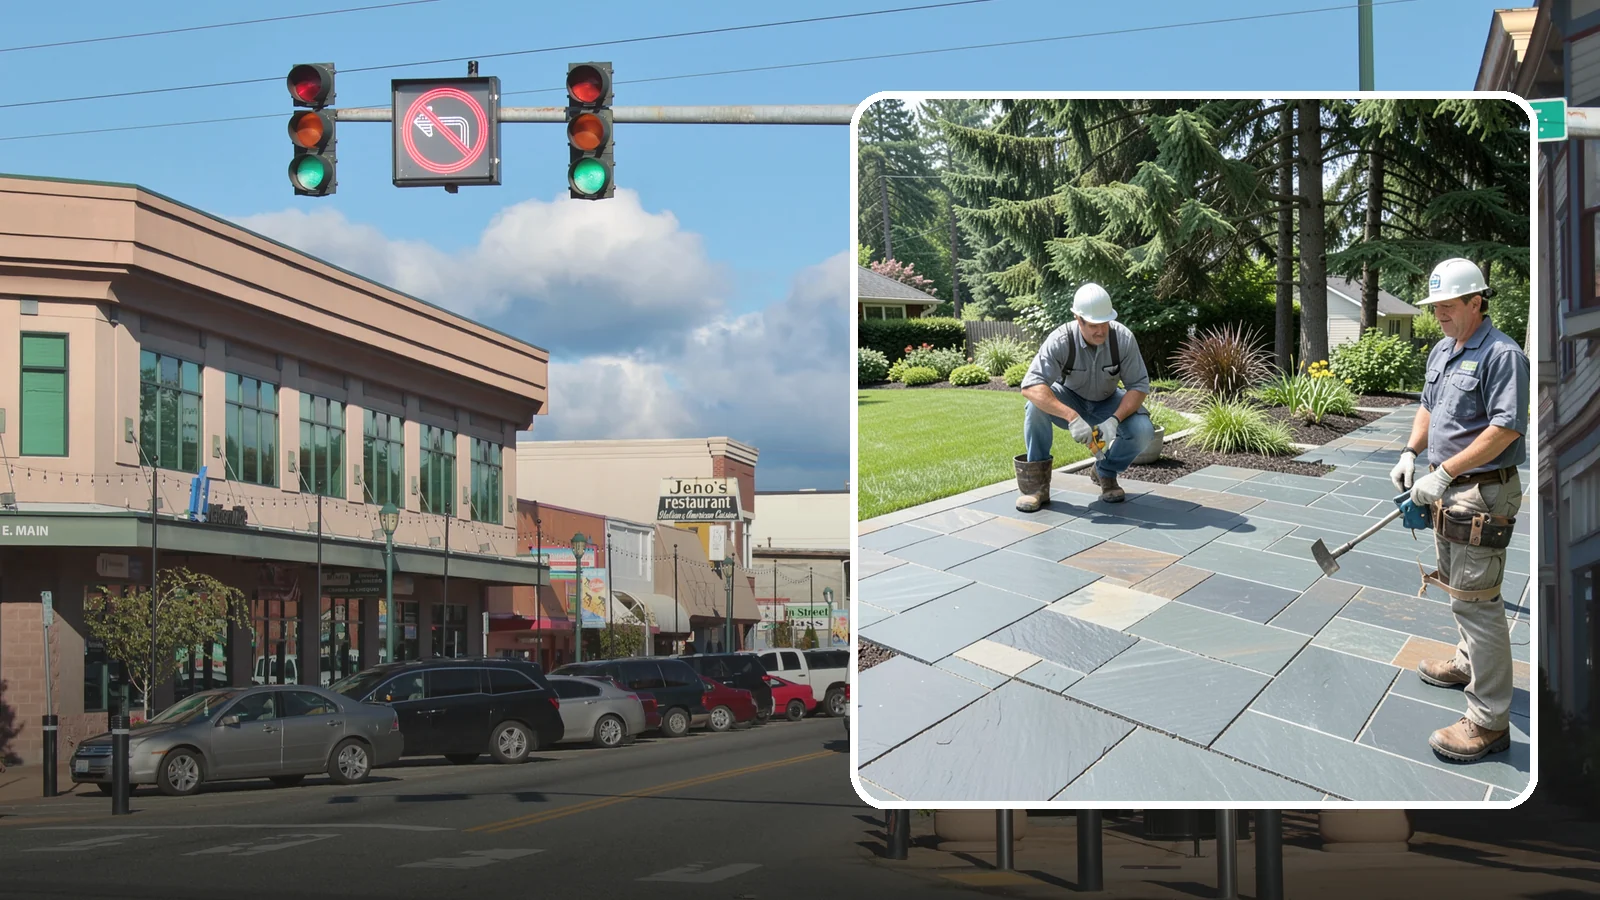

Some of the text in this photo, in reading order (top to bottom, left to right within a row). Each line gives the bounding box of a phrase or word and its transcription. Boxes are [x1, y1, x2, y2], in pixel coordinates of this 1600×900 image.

[669, 480, 728, 495] Jeno's
[665, 496, 731, 509] restaurant
[686, 509, 715, 519] American
[715, 509, 737, 519] Cuisine
[2, 525, 49, 536] E. MAIN
[797, 607, 828, 617] Street
[790, 619, 824, 627] lass
